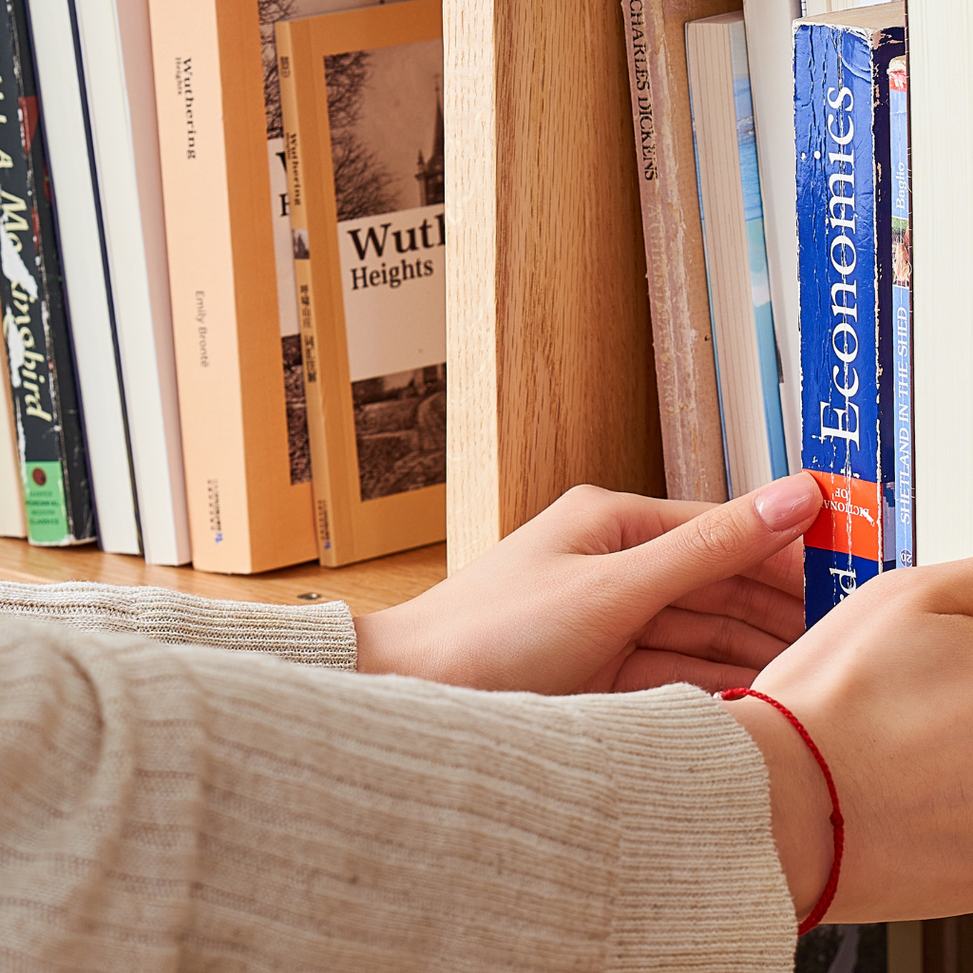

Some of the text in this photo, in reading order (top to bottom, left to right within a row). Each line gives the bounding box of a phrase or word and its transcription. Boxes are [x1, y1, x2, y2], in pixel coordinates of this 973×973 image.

[182, 57, 197, 161] Wuthering
[638, 96, 658, 181] DICKENS
[895, 162, 907, 209] Baglio
[351, 258, 434, 290] Heights
[814, 86, 861, 452] Economics
[195, 290, 206, 324] Emily
[897, 306, 911, 525] SHETLAND IN THE SHED
[822, 499, 871, 517] DICTIONA
[834, 487, 850, 499] OF
